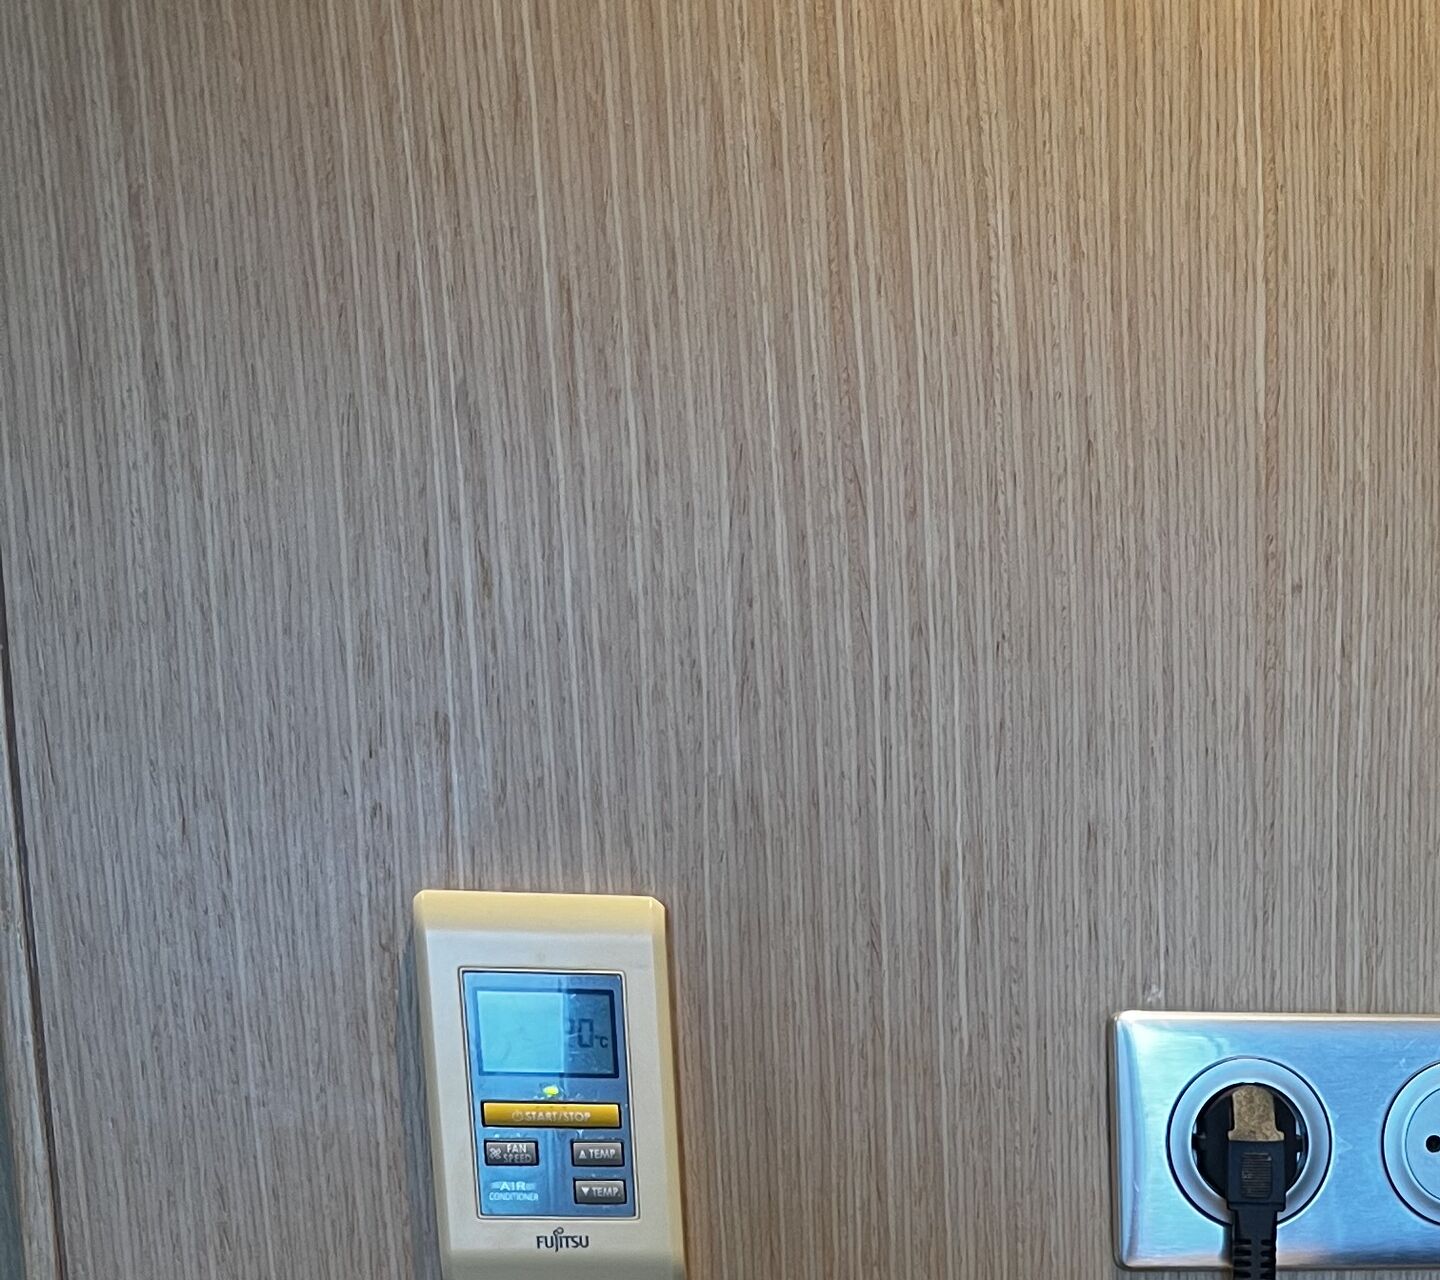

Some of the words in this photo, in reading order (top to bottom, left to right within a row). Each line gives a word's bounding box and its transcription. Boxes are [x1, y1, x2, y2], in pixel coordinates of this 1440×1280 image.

[526, 1111, 591, 1122] START/STOP
[506, 1144, 527, 1154] FAN
[503, 1154, 532, 1163] SPEED
[499, 1181, 527, 1191] AIR
[489, 1191, 539, 1201] CONDITIONER
[536, 1227, 590, 1253] FUJITSU
